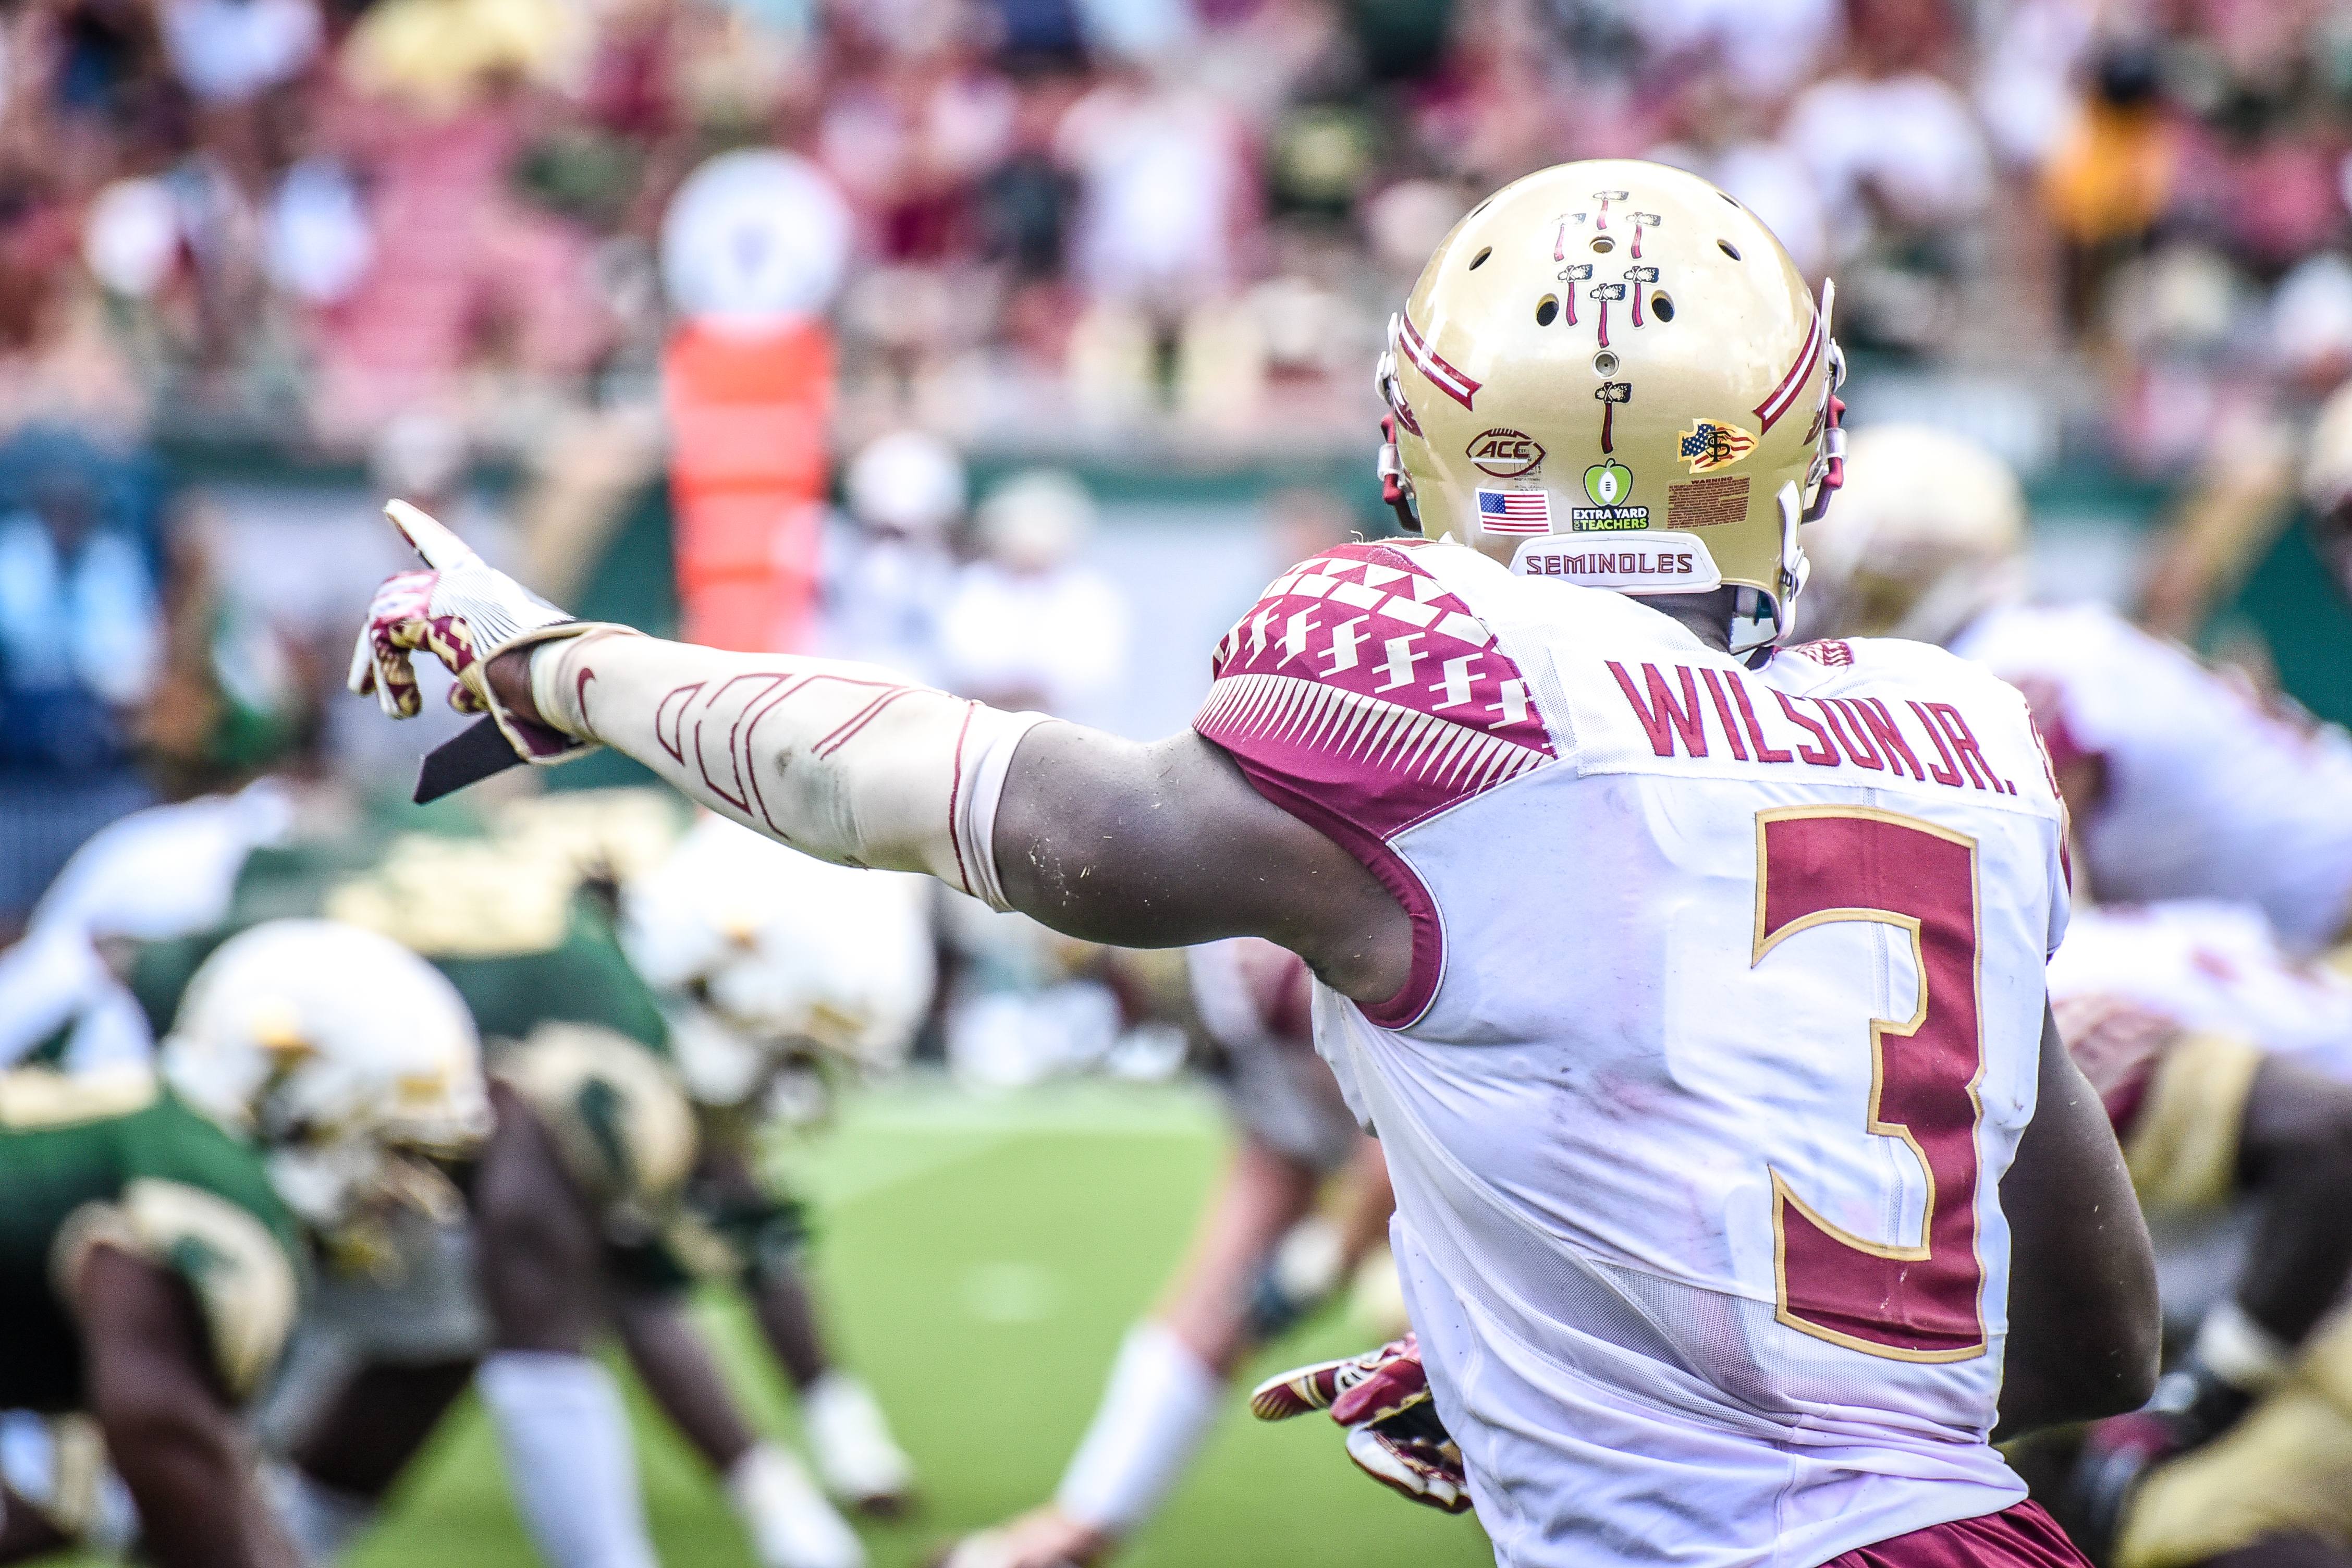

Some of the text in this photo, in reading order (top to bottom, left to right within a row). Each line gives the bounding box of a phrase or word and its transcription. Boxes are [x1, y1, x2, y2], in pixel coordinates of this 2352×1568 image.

[1476, 441, 1533, 458] ACC
[1691, 476, 1733, 484] WARNING
[1573, 508, 1647, 519] EXTRA YARD
[1580, 519, 1647, 530] TEACHERS
[1525, 553, 1693, 574] SEMINOLES
[1604, 660, 2018, 795] WILSON JR.
[1751, 804, 1988, 1364] 3
